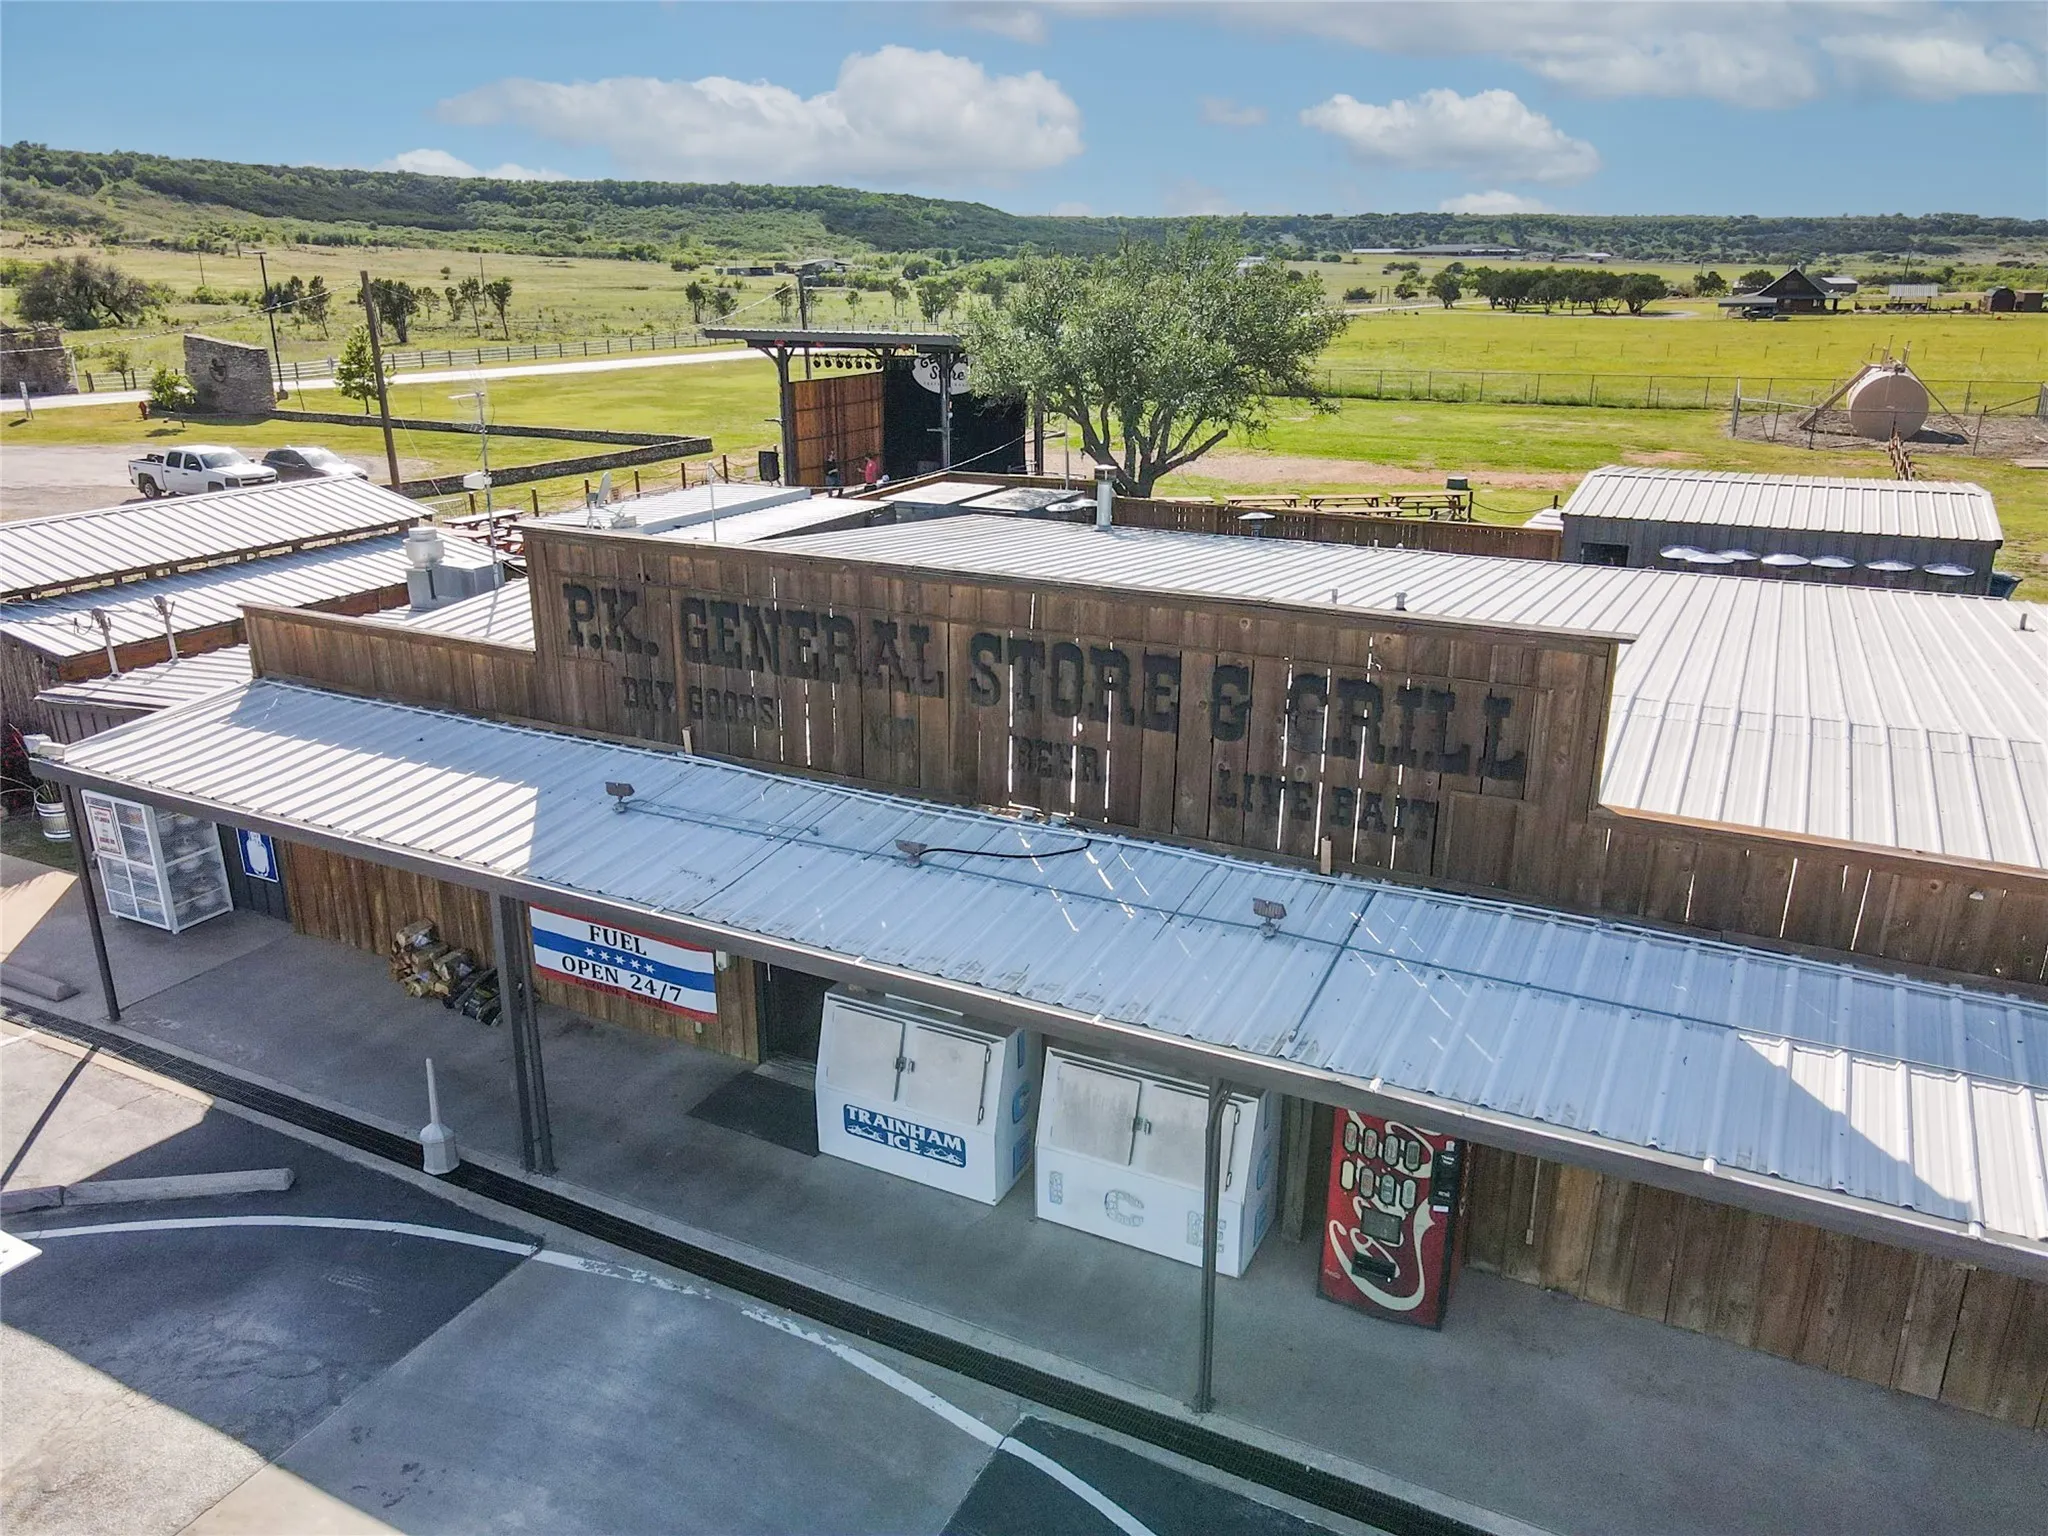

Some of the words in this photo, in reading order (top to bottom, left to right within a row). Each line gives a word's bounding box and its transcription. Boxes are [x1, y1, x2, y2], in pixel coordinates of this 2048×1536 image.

[563, 583, 659, 657] P.K.
[681, 598, 944, 699] GENERAL
[970, 632, 1181, 734] STORE
[1287, 672, 1525, 780] GRILL
[688, 685, 775, 731] GOODS
[1330, 786, 1435, 841] BAIT
[588, 924, 647, 956] FUEL
[562, 955, 619, 985] OPEN
[630, 973, 682, 1003] 24/7
[846, 1104, 964, 1152] TRAINHAM
[887, 1132, 922, 1154] ICE
